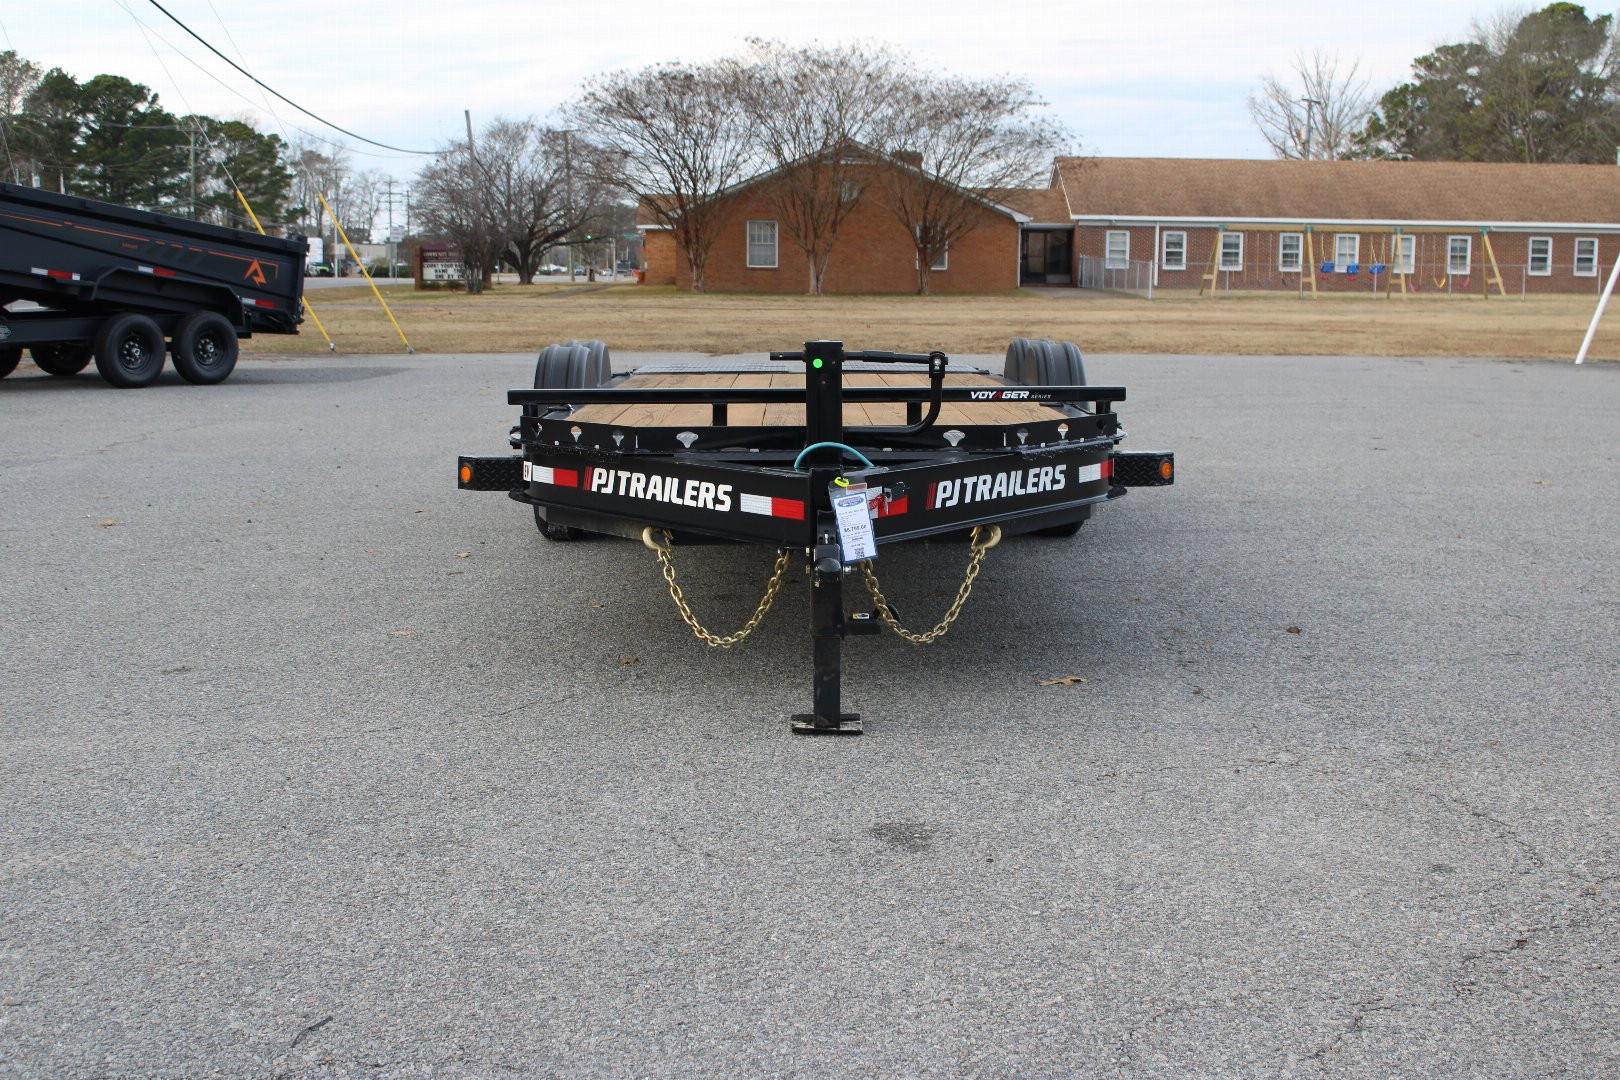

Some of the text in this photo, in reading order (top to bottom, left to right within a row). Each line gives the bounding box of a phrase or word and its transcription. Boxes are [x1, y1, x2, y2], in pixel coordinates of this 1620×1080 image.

[970, 390, 1030, 399] VOYAGER
[617, 470, 733, 512] TRAILERS
[963, 464, 1067, 504] TRAILERS
